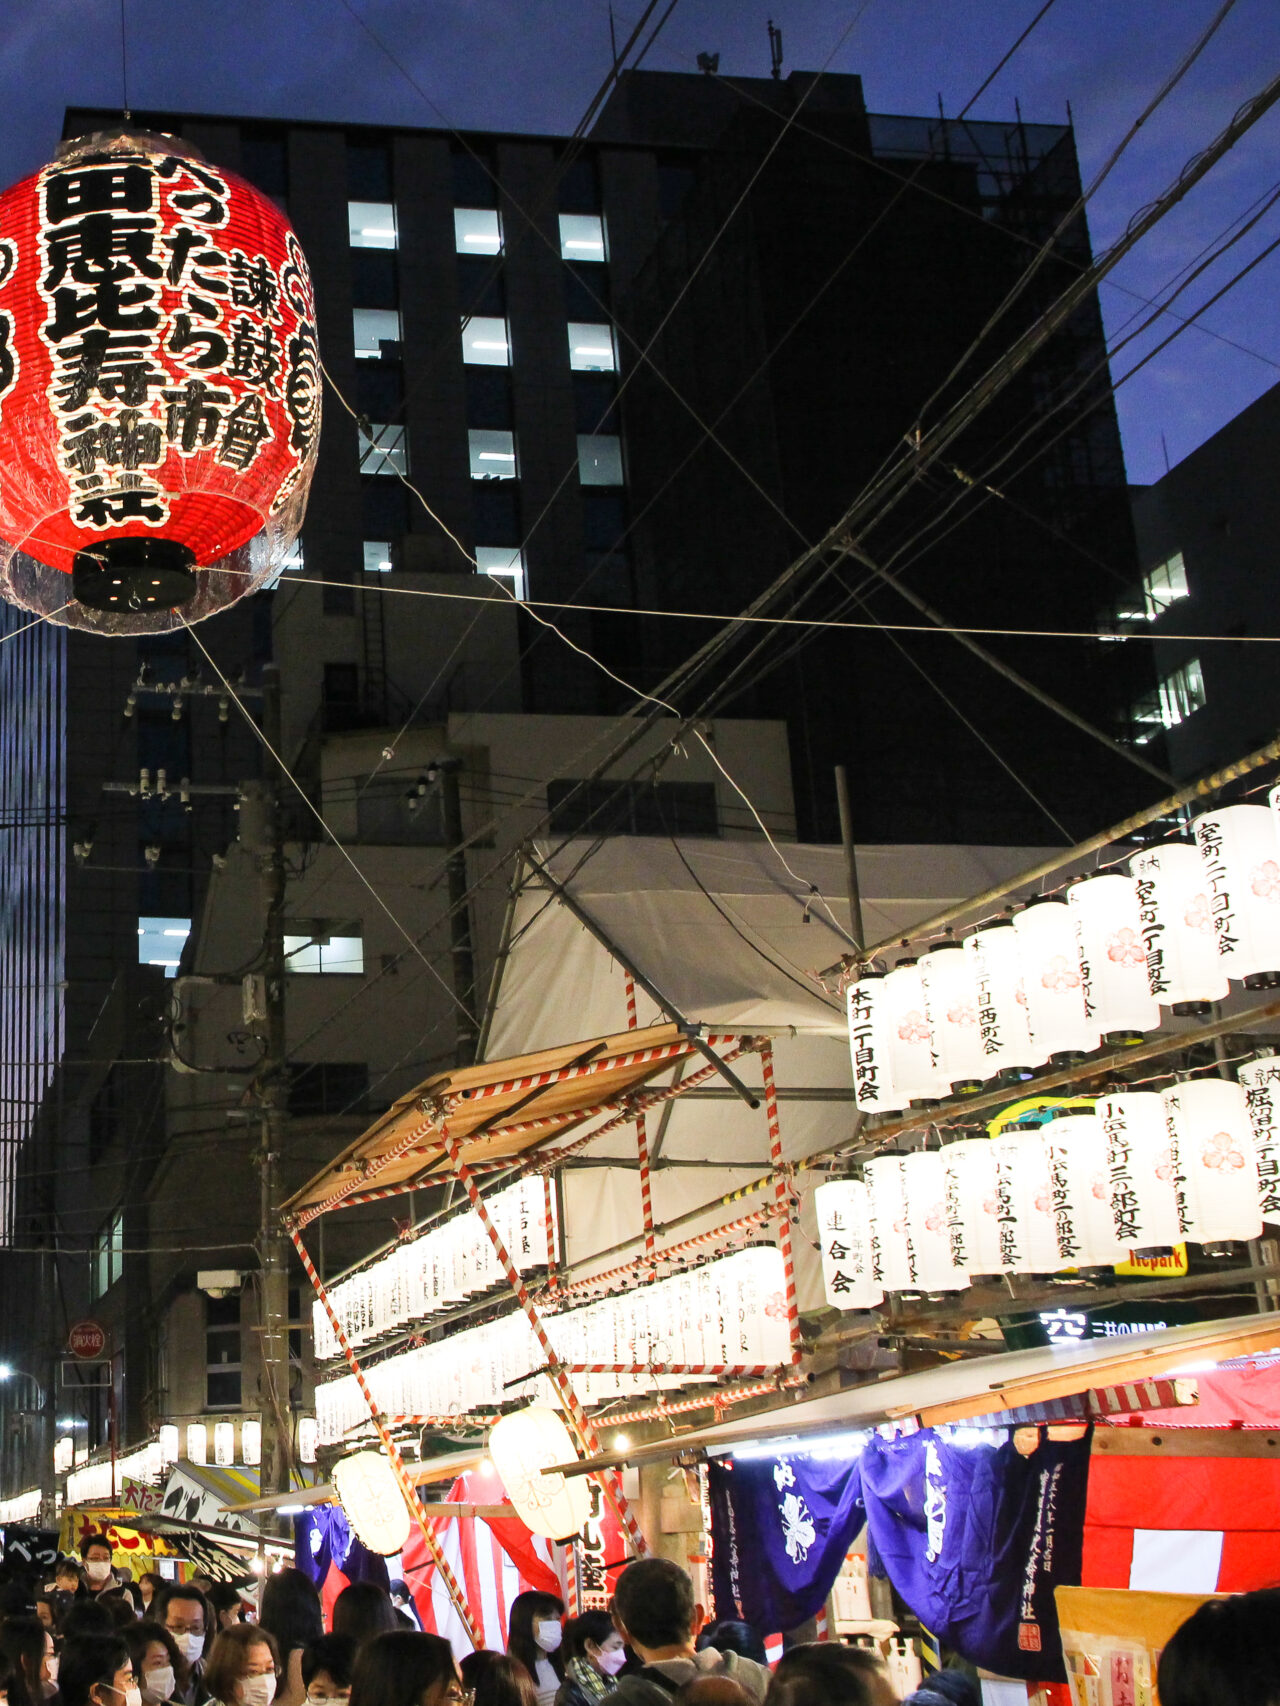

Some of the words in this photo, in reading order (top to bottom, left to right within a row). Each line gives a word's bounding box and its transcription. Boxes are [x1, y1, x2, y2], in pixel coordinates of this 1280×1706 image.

[43, 152, 167, 527] 田恵比寿神社
[851, 988, 880, 1102] 本町一丁目町会
[826, 1211, 856, 1293] 連合会
